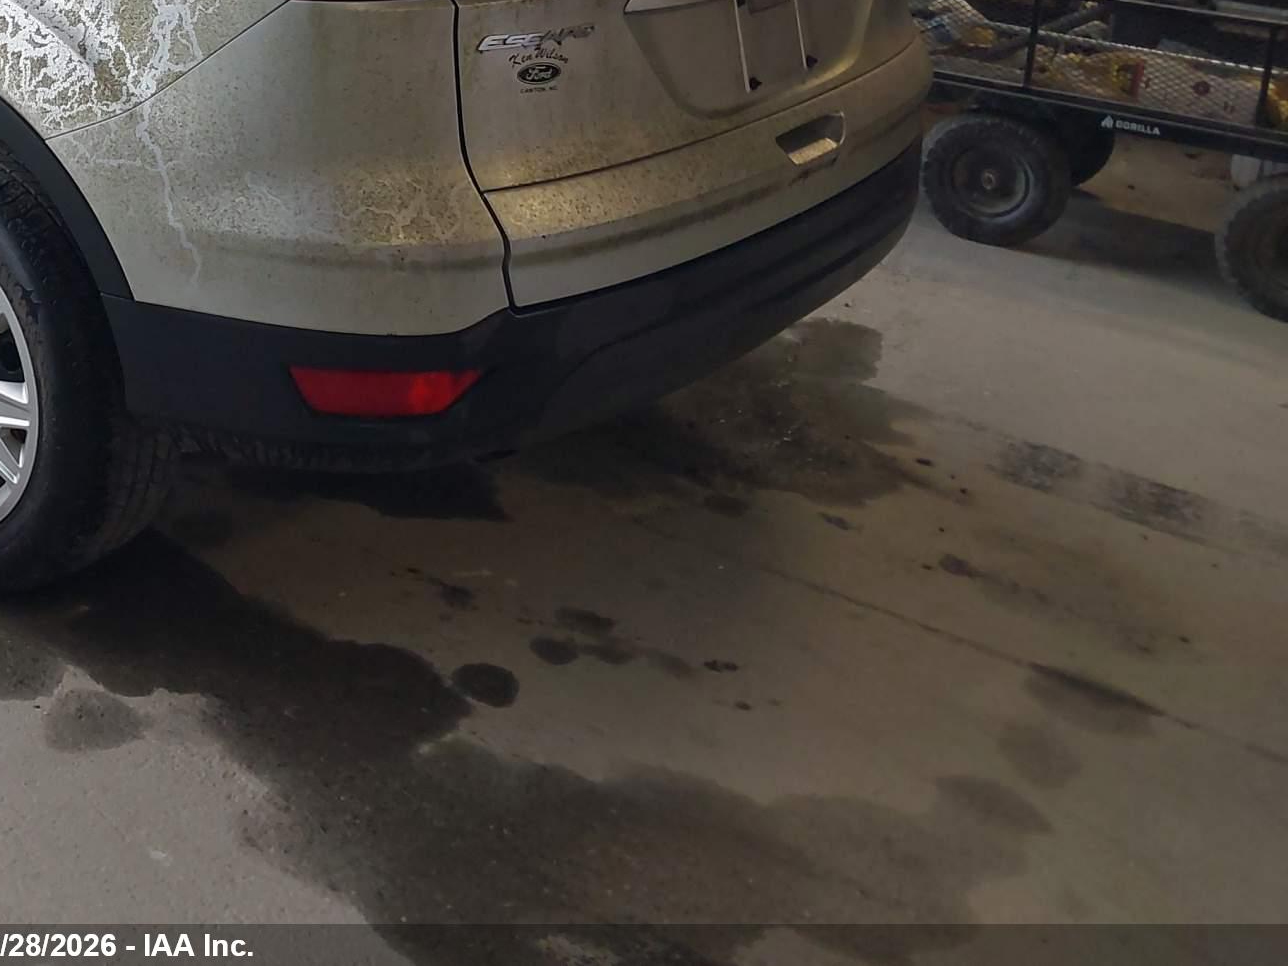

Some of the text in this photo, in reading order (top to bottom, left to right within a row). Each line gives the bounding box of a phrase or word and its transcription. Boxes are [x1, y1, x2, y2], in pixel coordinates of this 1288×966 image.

[509, 43, 569, 67] Ken Wilson
[523, 65, 555, 81] Ford
[1115, 119, 1161, 136] GORILLA
